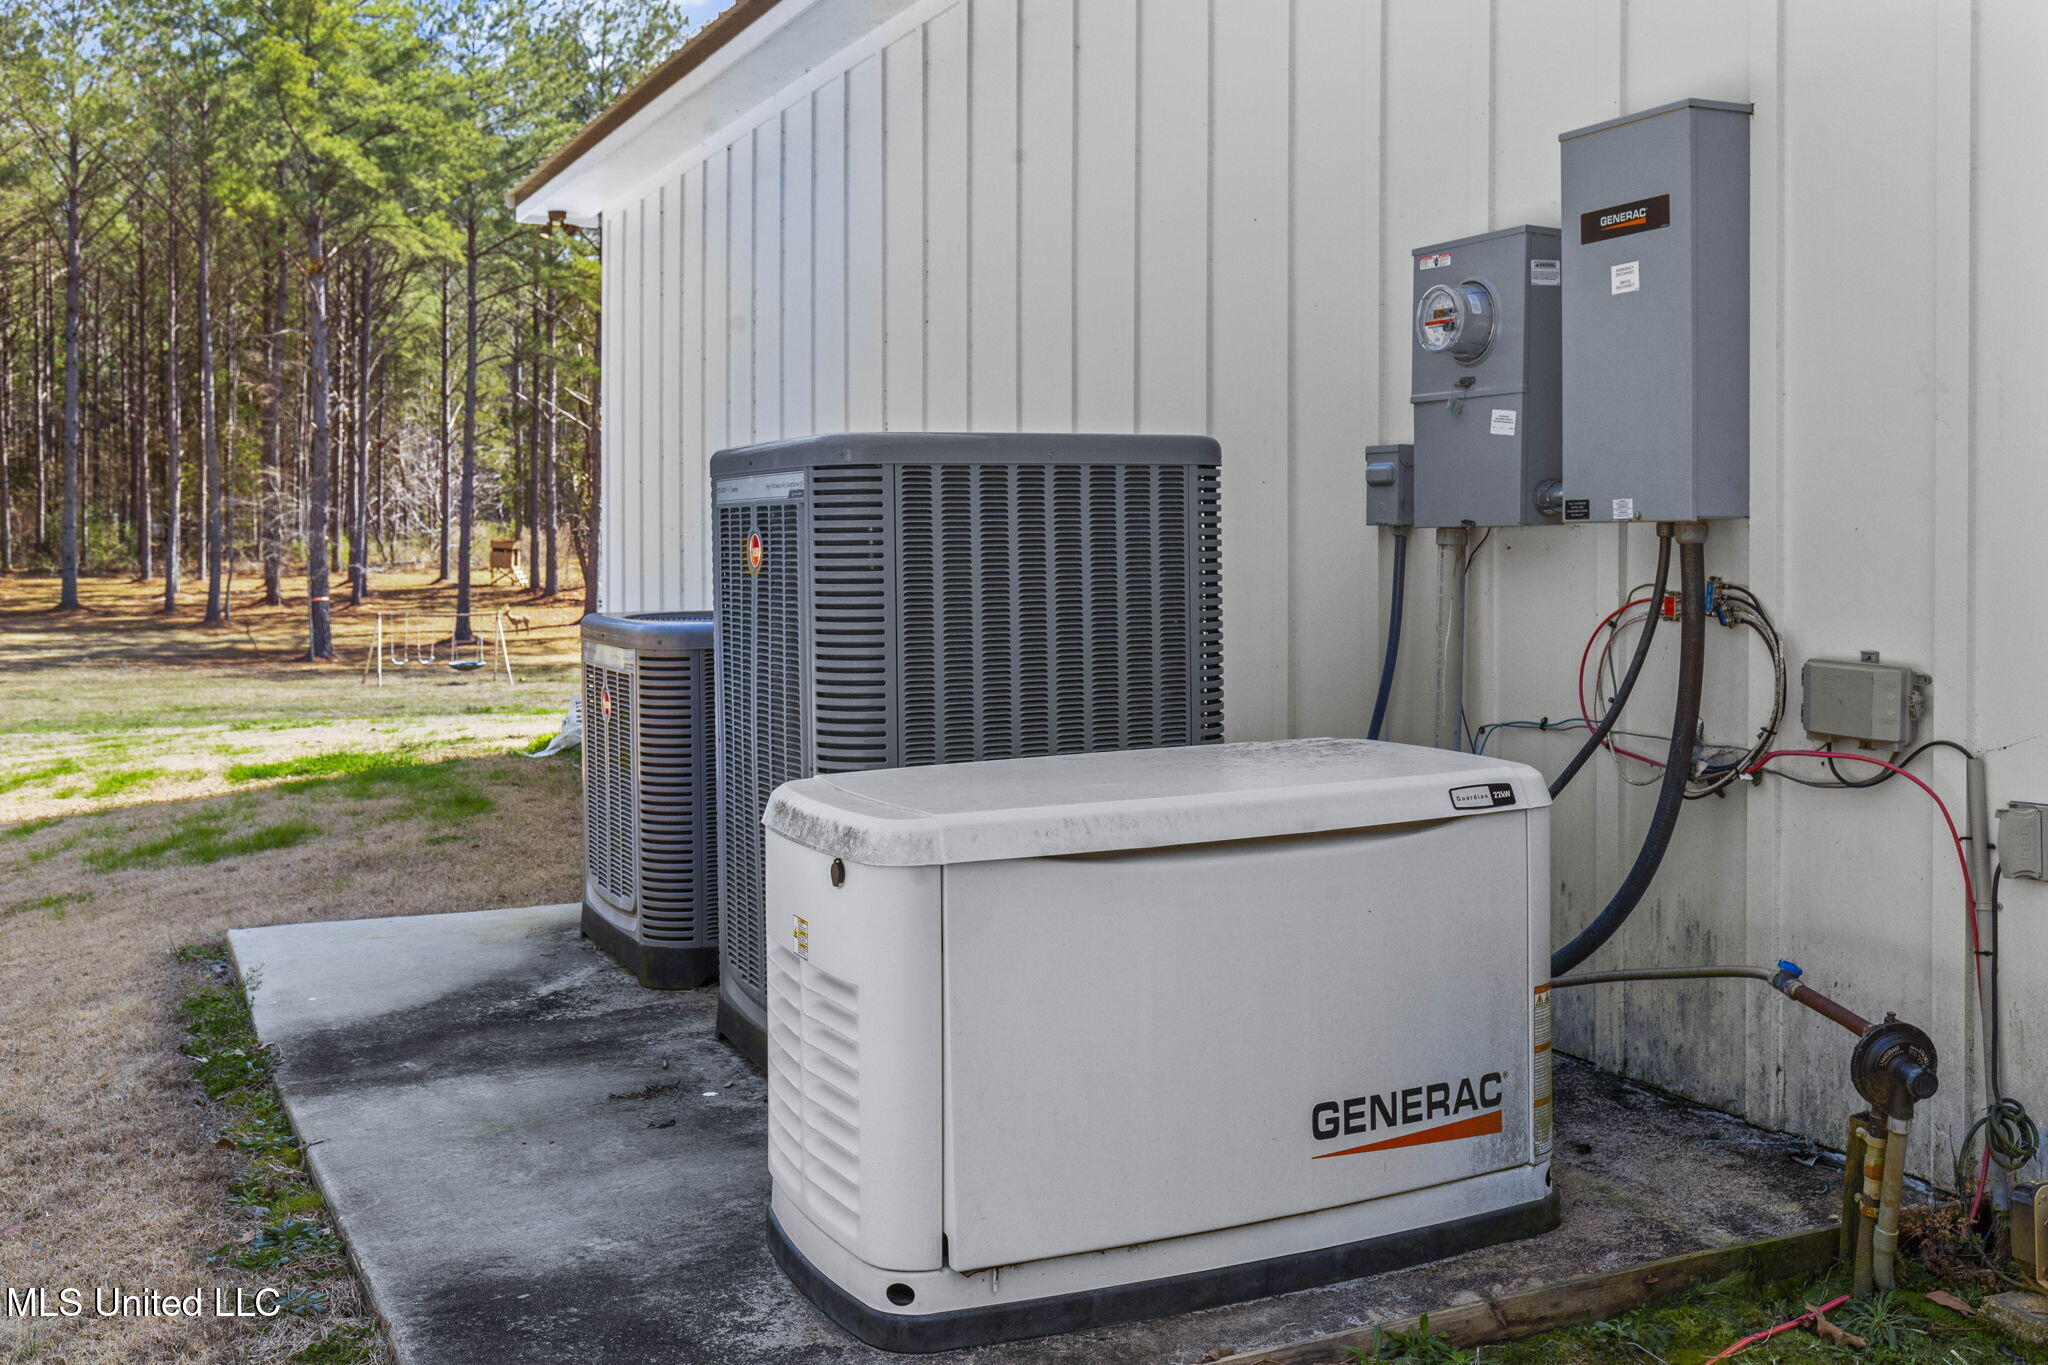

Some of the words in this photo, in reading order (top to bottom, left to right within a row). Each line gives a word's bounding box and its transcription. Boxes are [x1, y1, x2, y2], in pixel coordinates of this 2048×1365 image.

[1600, 208, 1647, 226] GENERAC
[1456, 794, 1489, 802] Guardian
[1312, 1072, 1503, 1140] GENERAC
